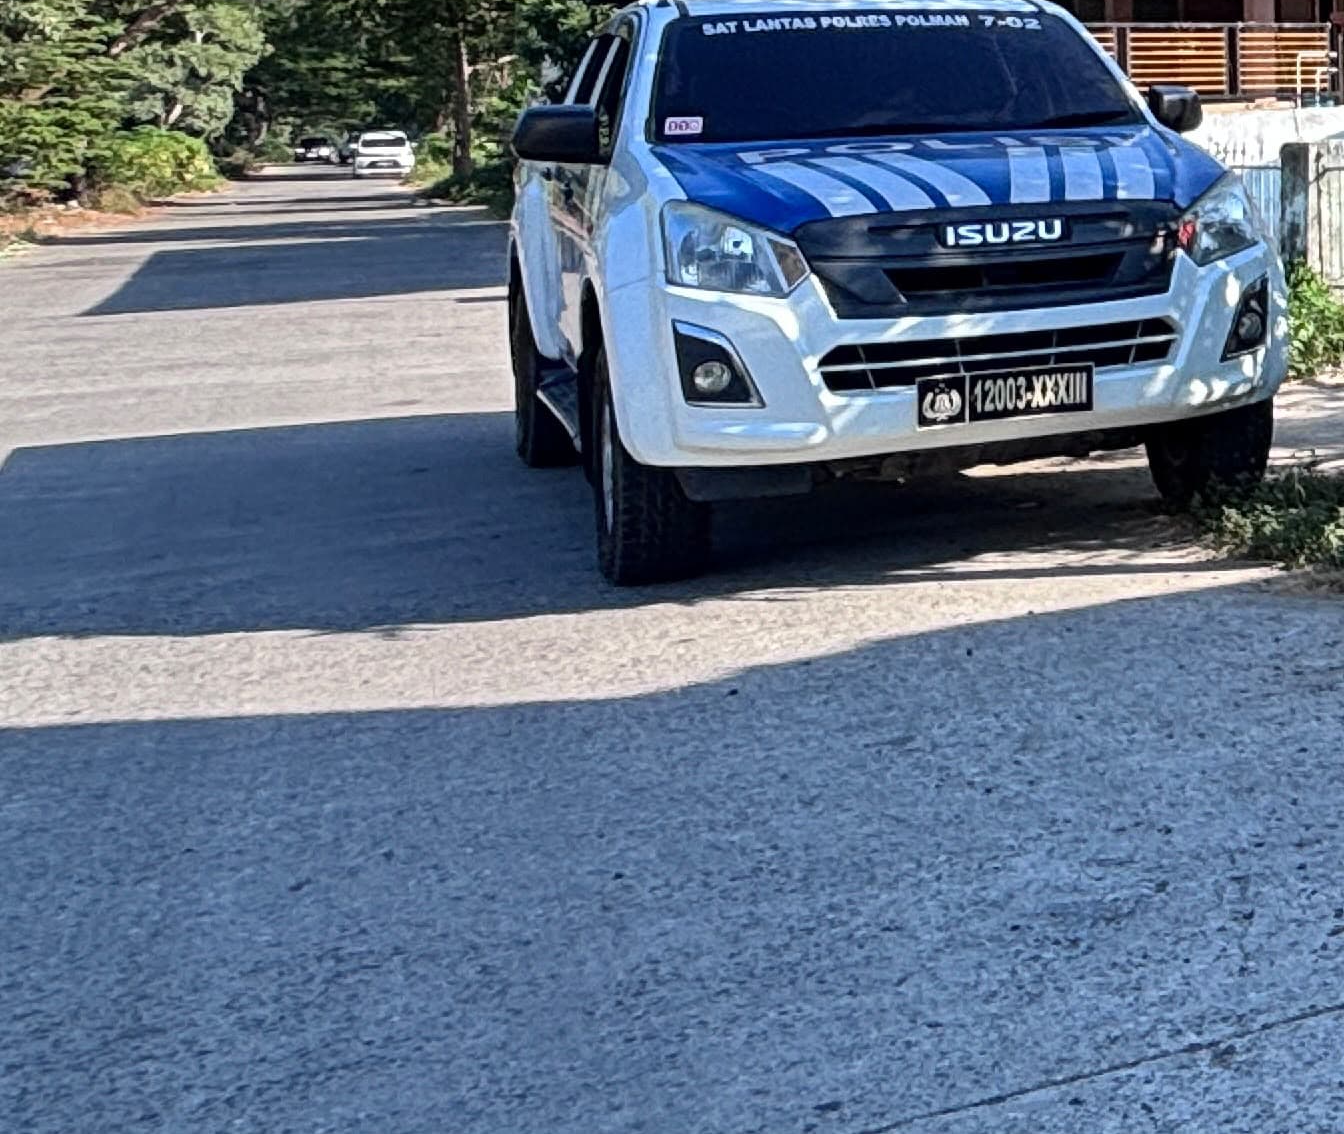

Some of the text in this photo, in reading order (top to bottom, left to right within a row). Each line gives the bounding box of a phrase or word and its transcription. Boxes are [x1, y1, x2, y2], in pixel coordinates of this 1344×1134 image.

[702, 14, 1042, 36] SAT LANTAS POLRES POLMAN 7-02
[945, 218, 1063, 247] ISUZU
[974, 371, 1088, 414] 12003-XXXIII
